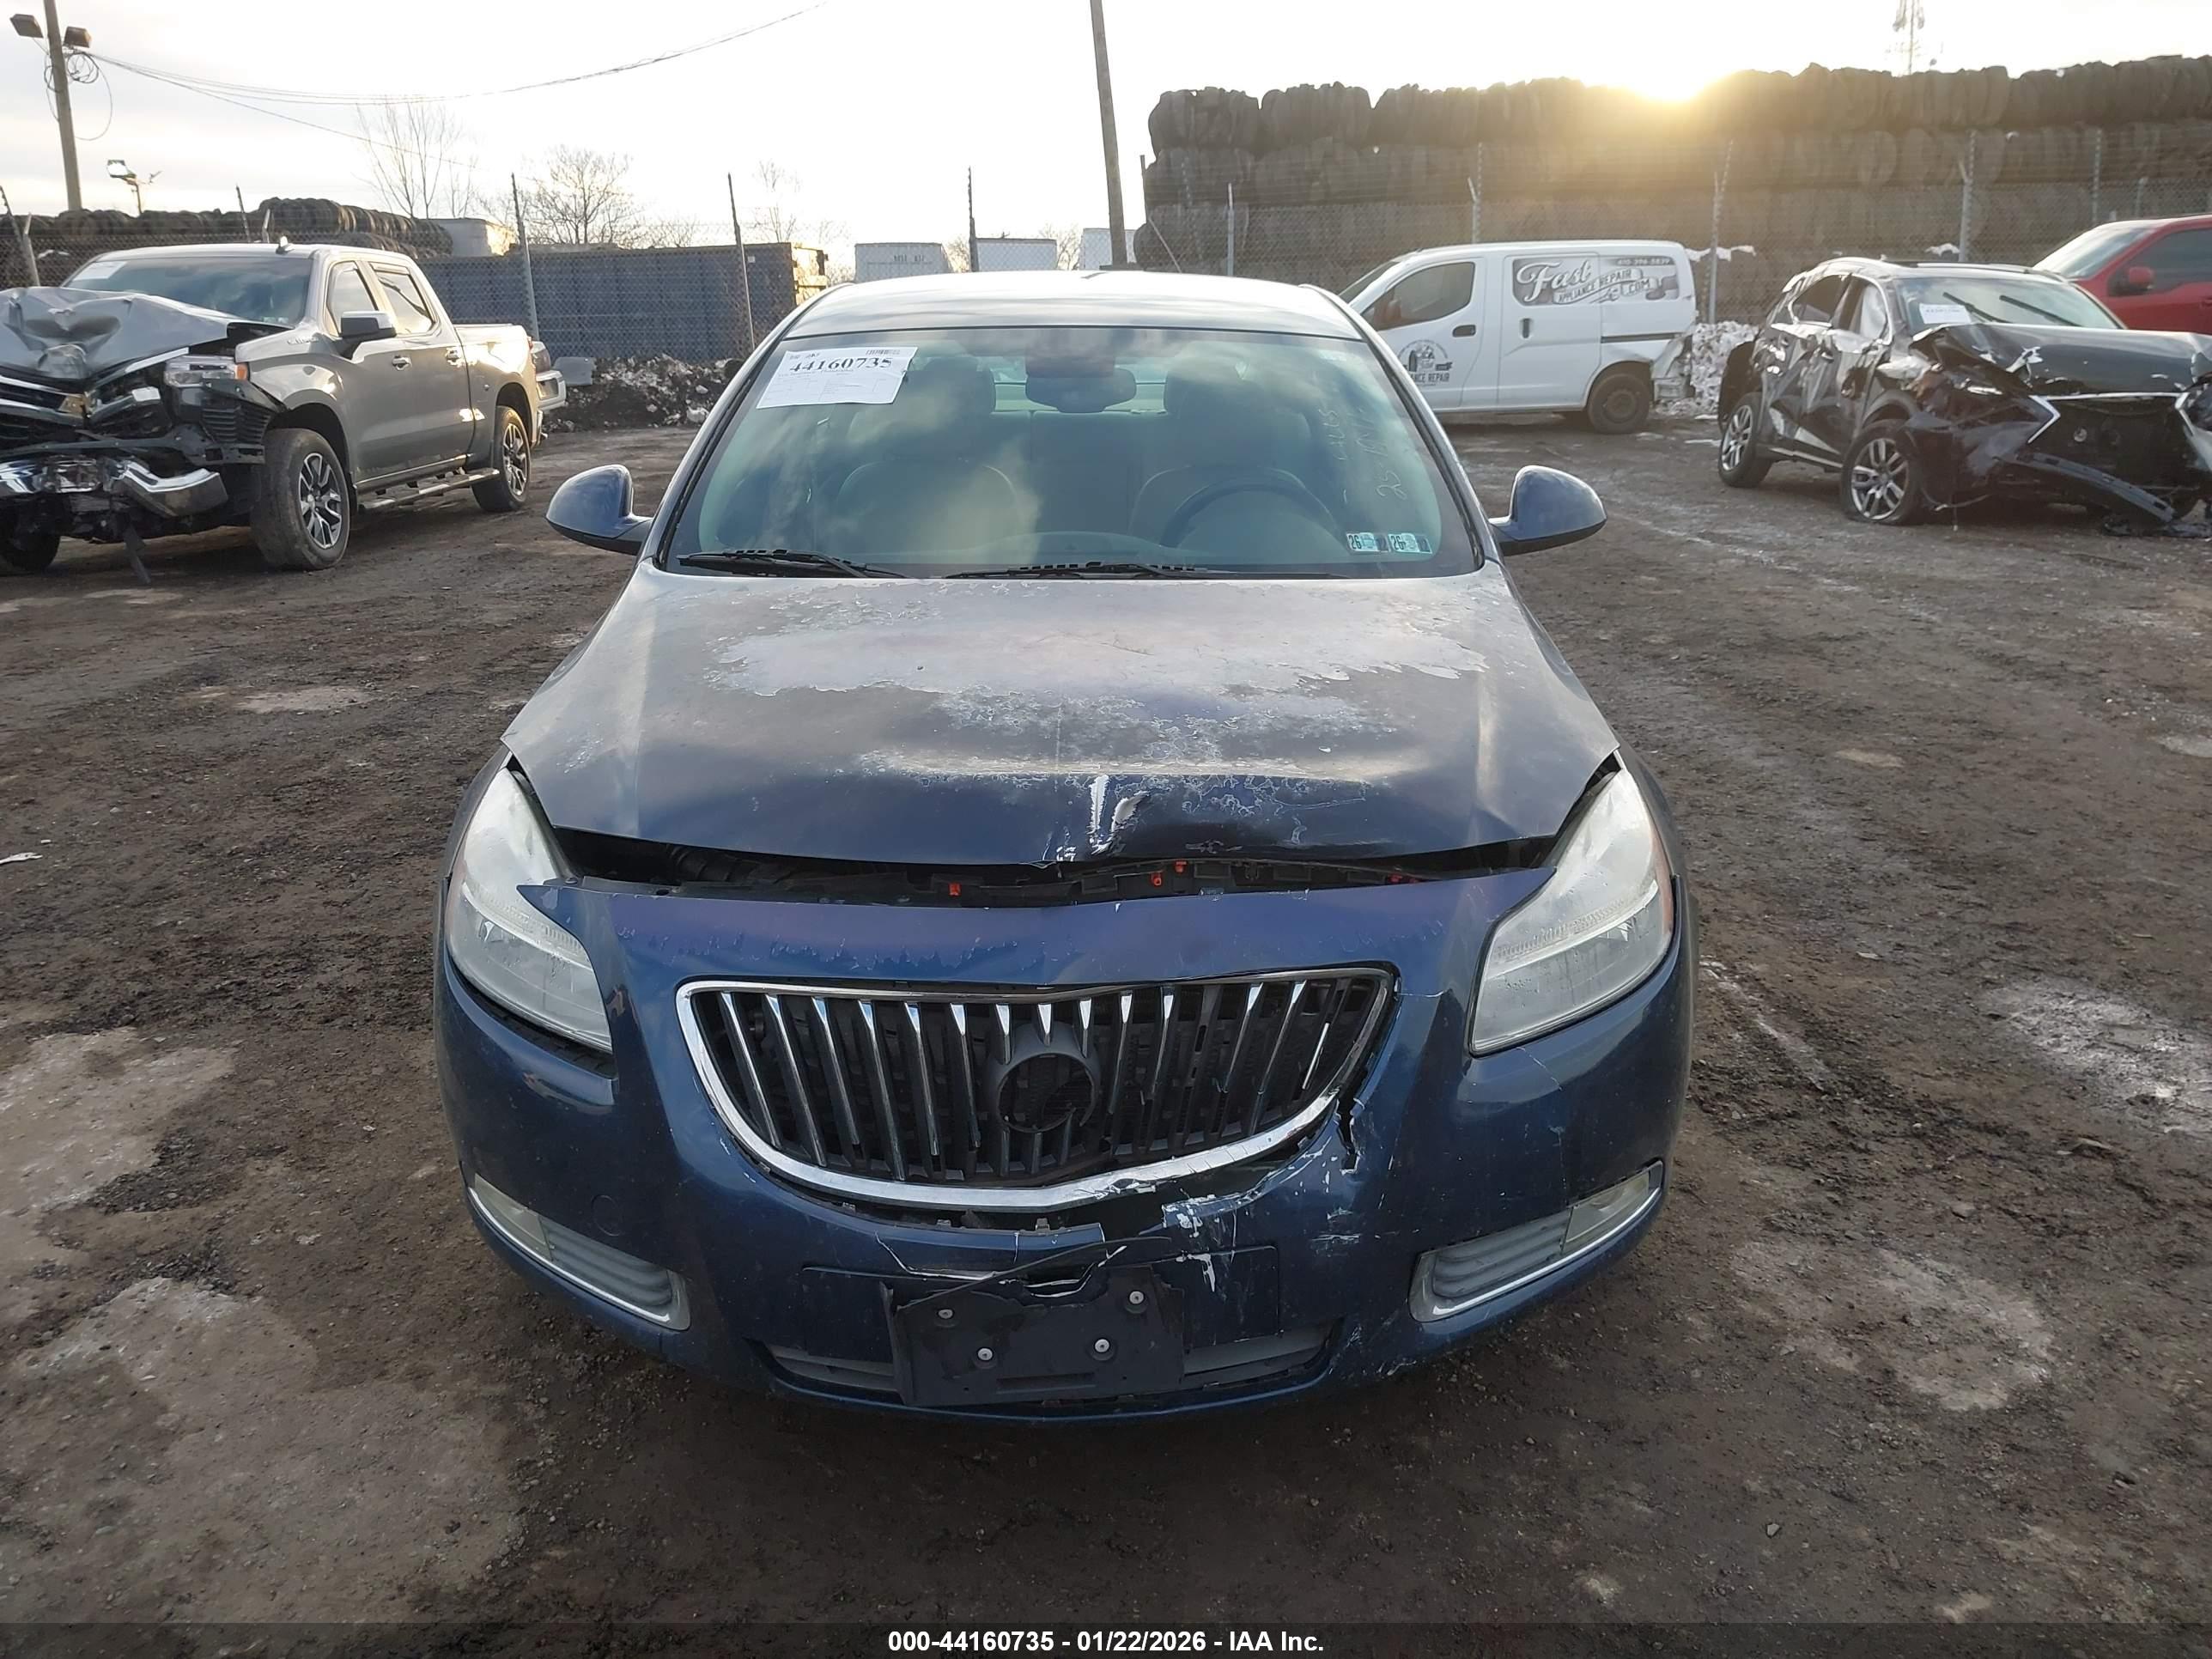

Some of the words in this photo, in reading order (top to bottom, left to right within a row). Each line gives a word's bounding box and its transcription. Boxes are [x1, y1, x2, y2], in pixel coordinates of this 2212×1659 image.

[1516, 259, 1591, 302] Fast
[1600, 269, 1632, 285] REPAIR
[789, 357, 892, 372] 44160735
[1348, 534, 1362, 550] 26
[1390, 535, 1406, 550] 26
